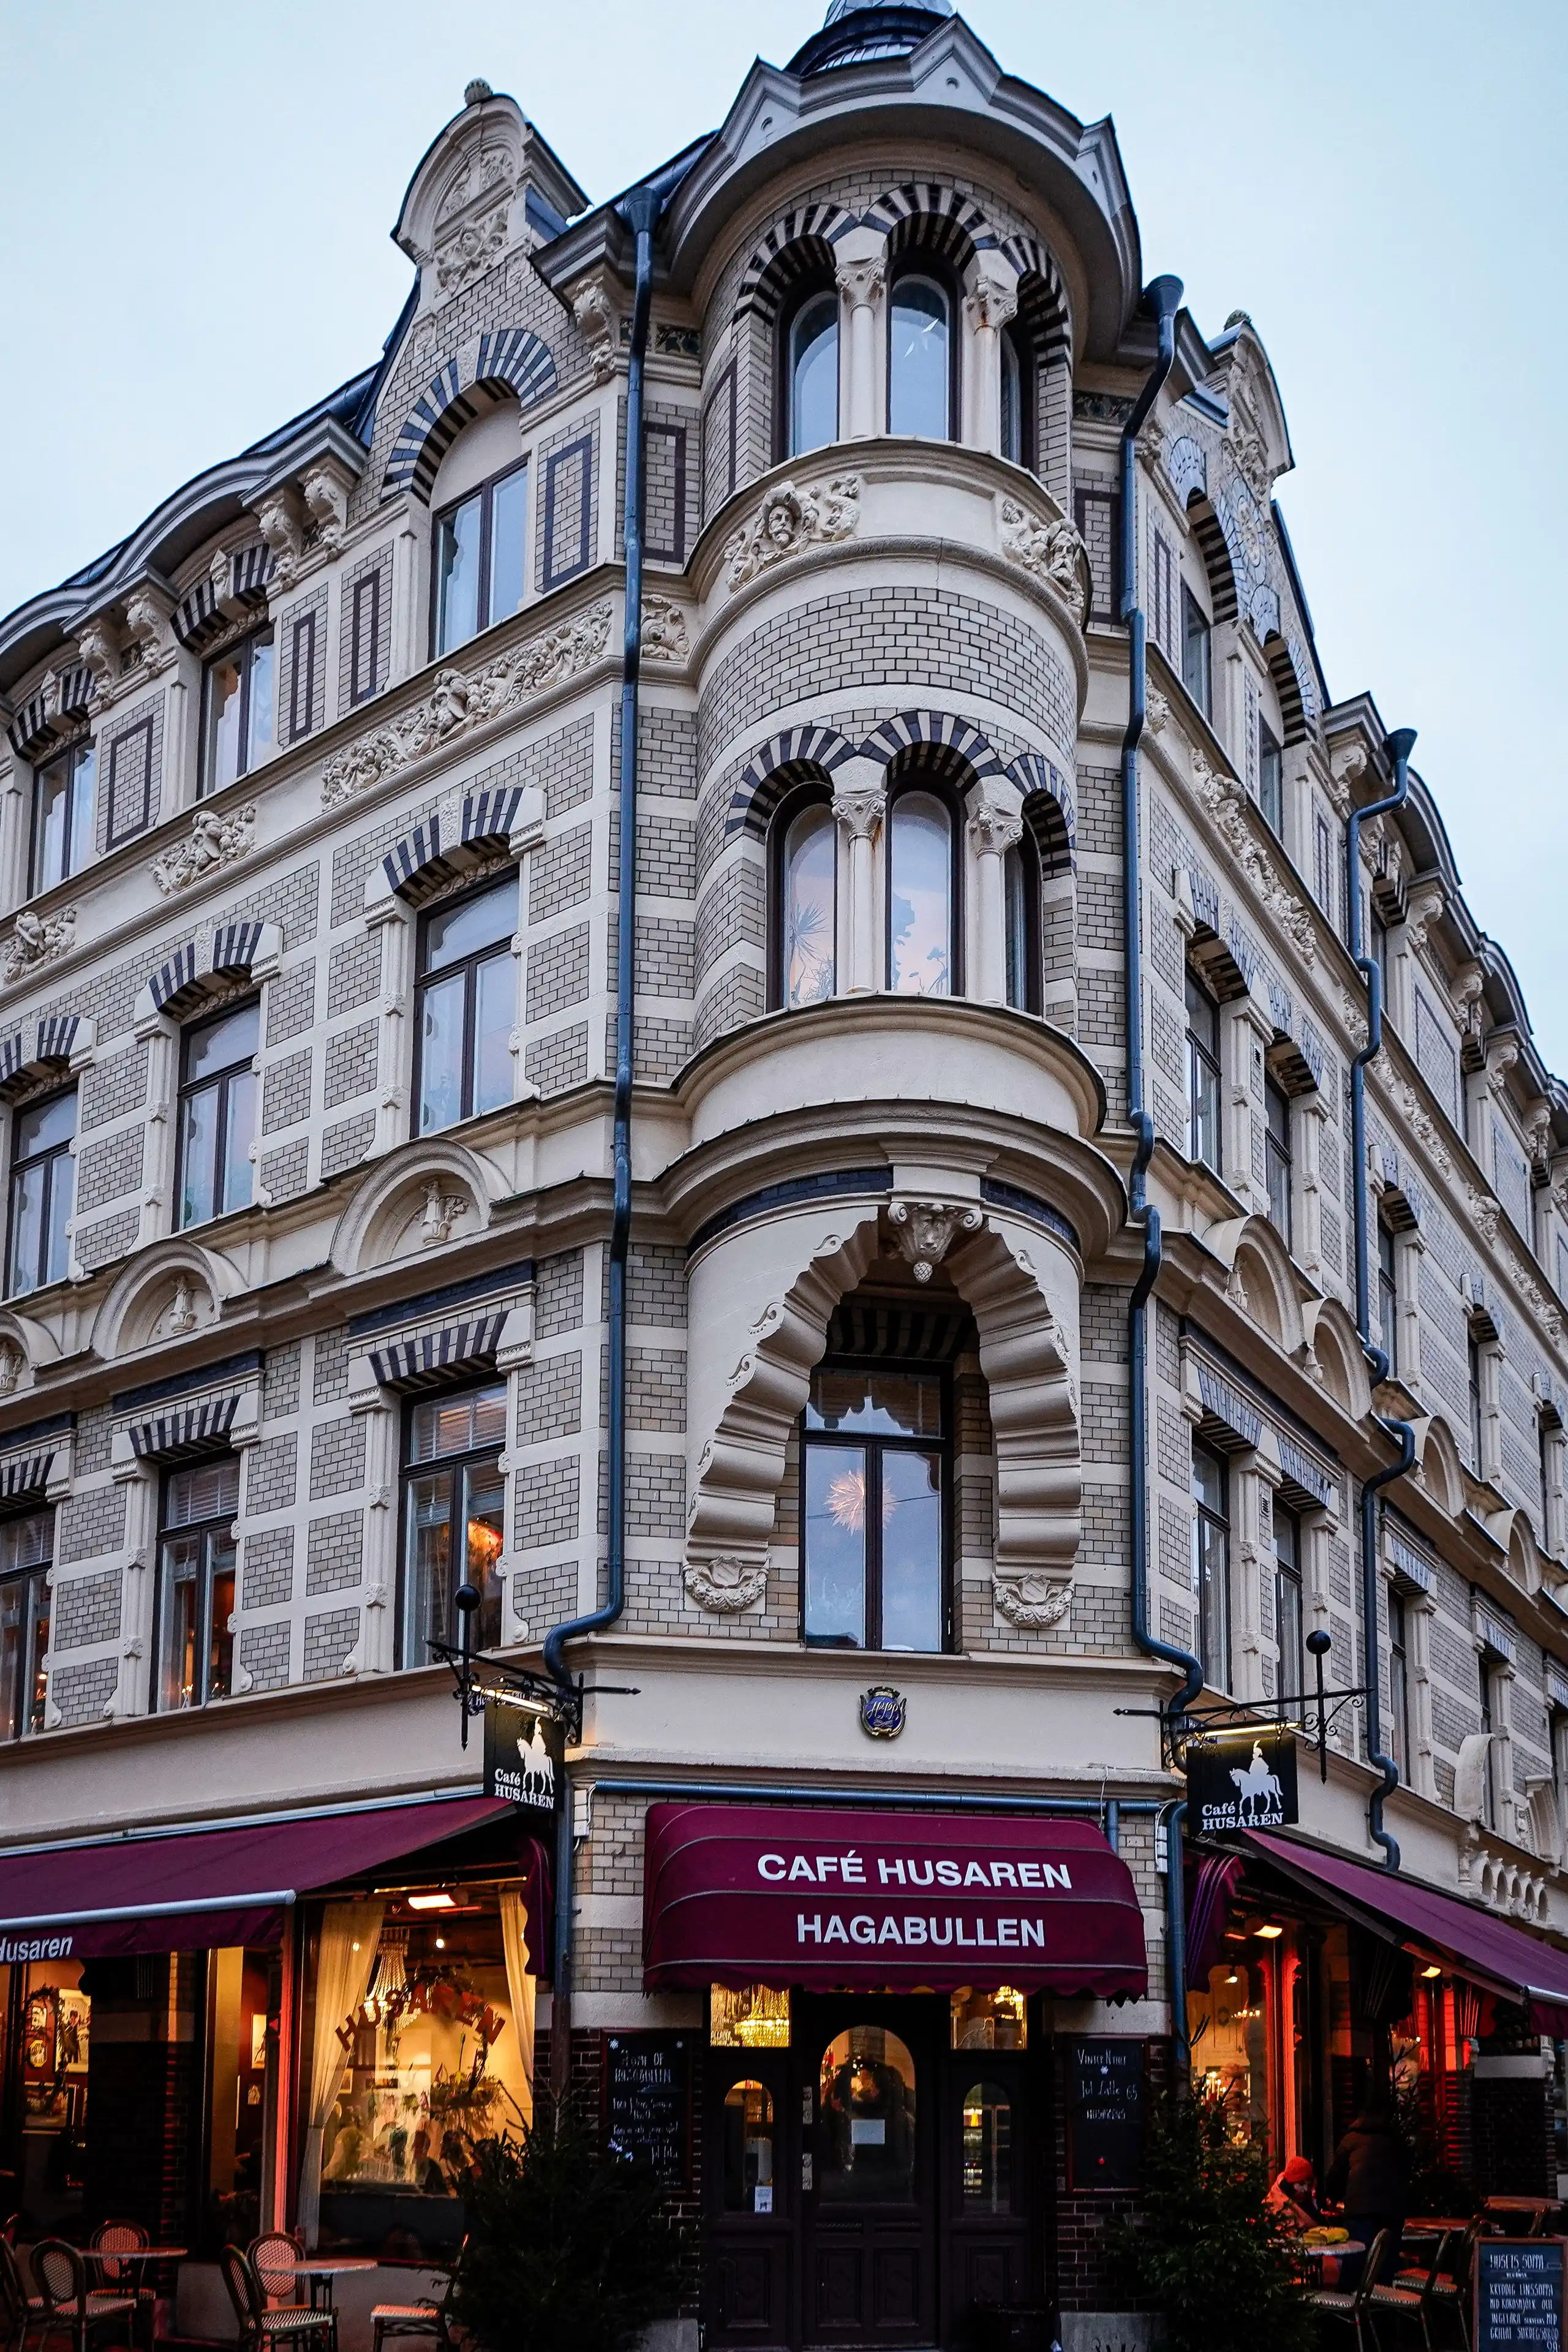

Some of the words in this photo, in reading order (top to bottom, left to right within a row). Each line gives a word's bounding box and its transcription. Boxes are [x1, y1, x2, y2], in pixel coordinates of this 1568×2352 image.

[495, 1768, 521, 1786] Café
[494, 1783, 554, 1809] HUSAREN
[1202, 1801, 1235, 1816] Café
[1202, 1812, 1283, 1830] HUSAREN
[757, 1850, 867, 1883] CAFÉ
[877, 1858, 1072, 1889] HUSAREN
[797, 1913, 1045, 1947] HAGABULLEN
[1490, 2283, 1515, 2296] KRYDDIG
[1519, 2283, 1553, 2297] LINSSOPPA
